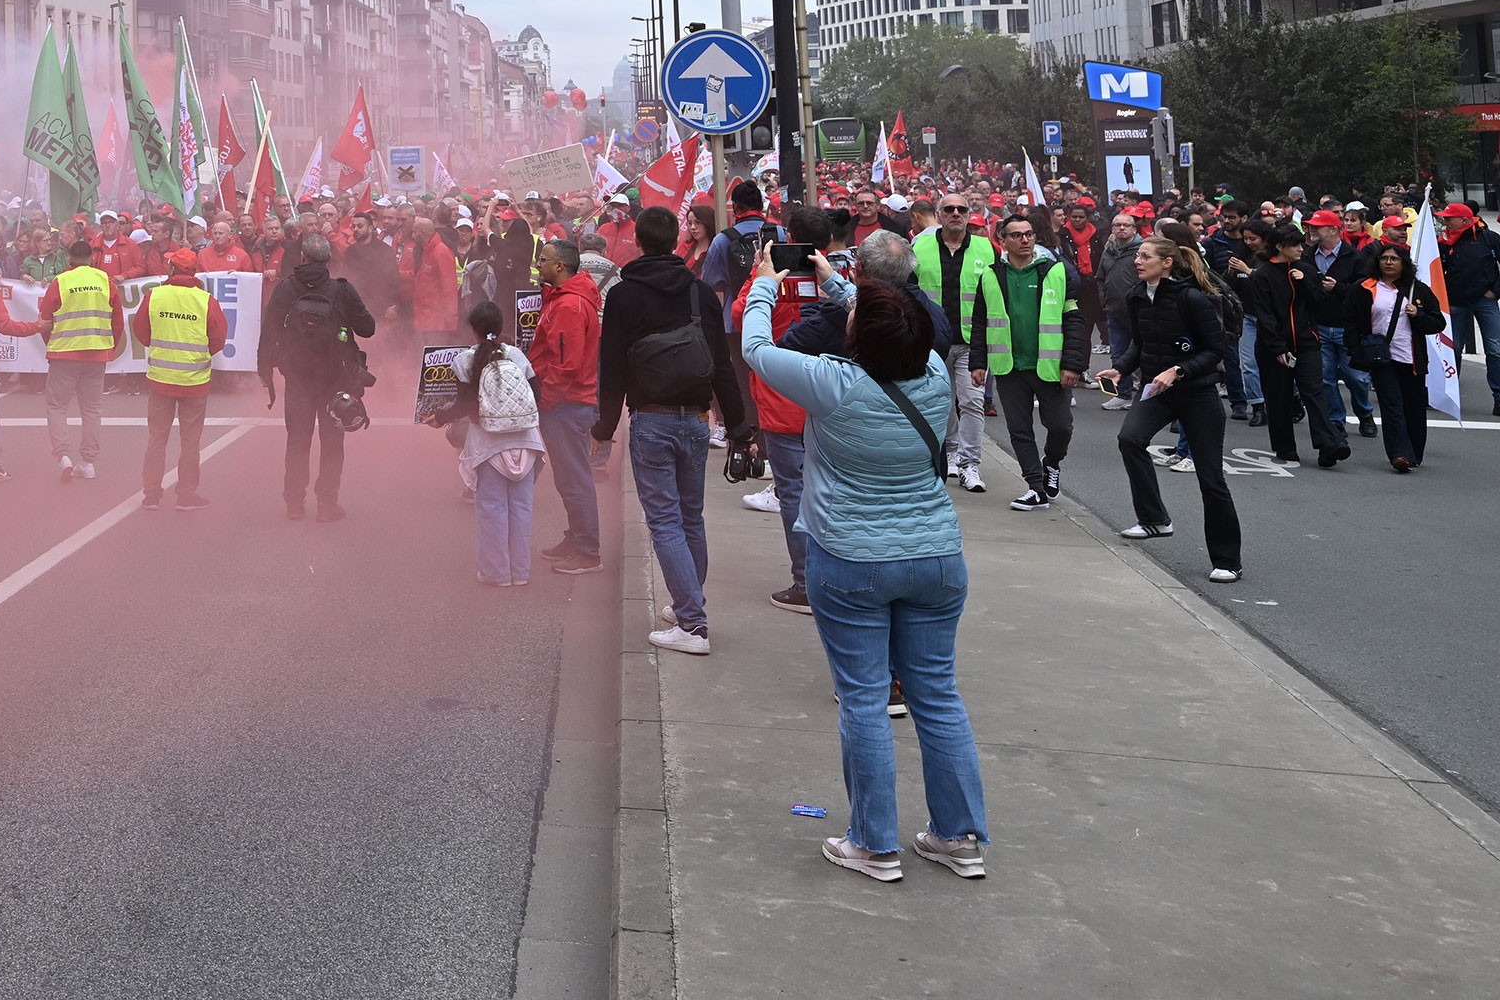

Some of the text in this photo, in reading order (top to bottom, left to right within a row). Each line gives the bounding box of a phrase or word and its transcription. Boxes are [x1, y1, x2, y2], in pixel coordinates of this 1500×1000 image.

[1116, 109, 1137, 118] Rogier
[1046, 125, 1059, 142] P
[69, 285, 103, 294] STEWARD
[159, 311, 198, 321] STEWARD
